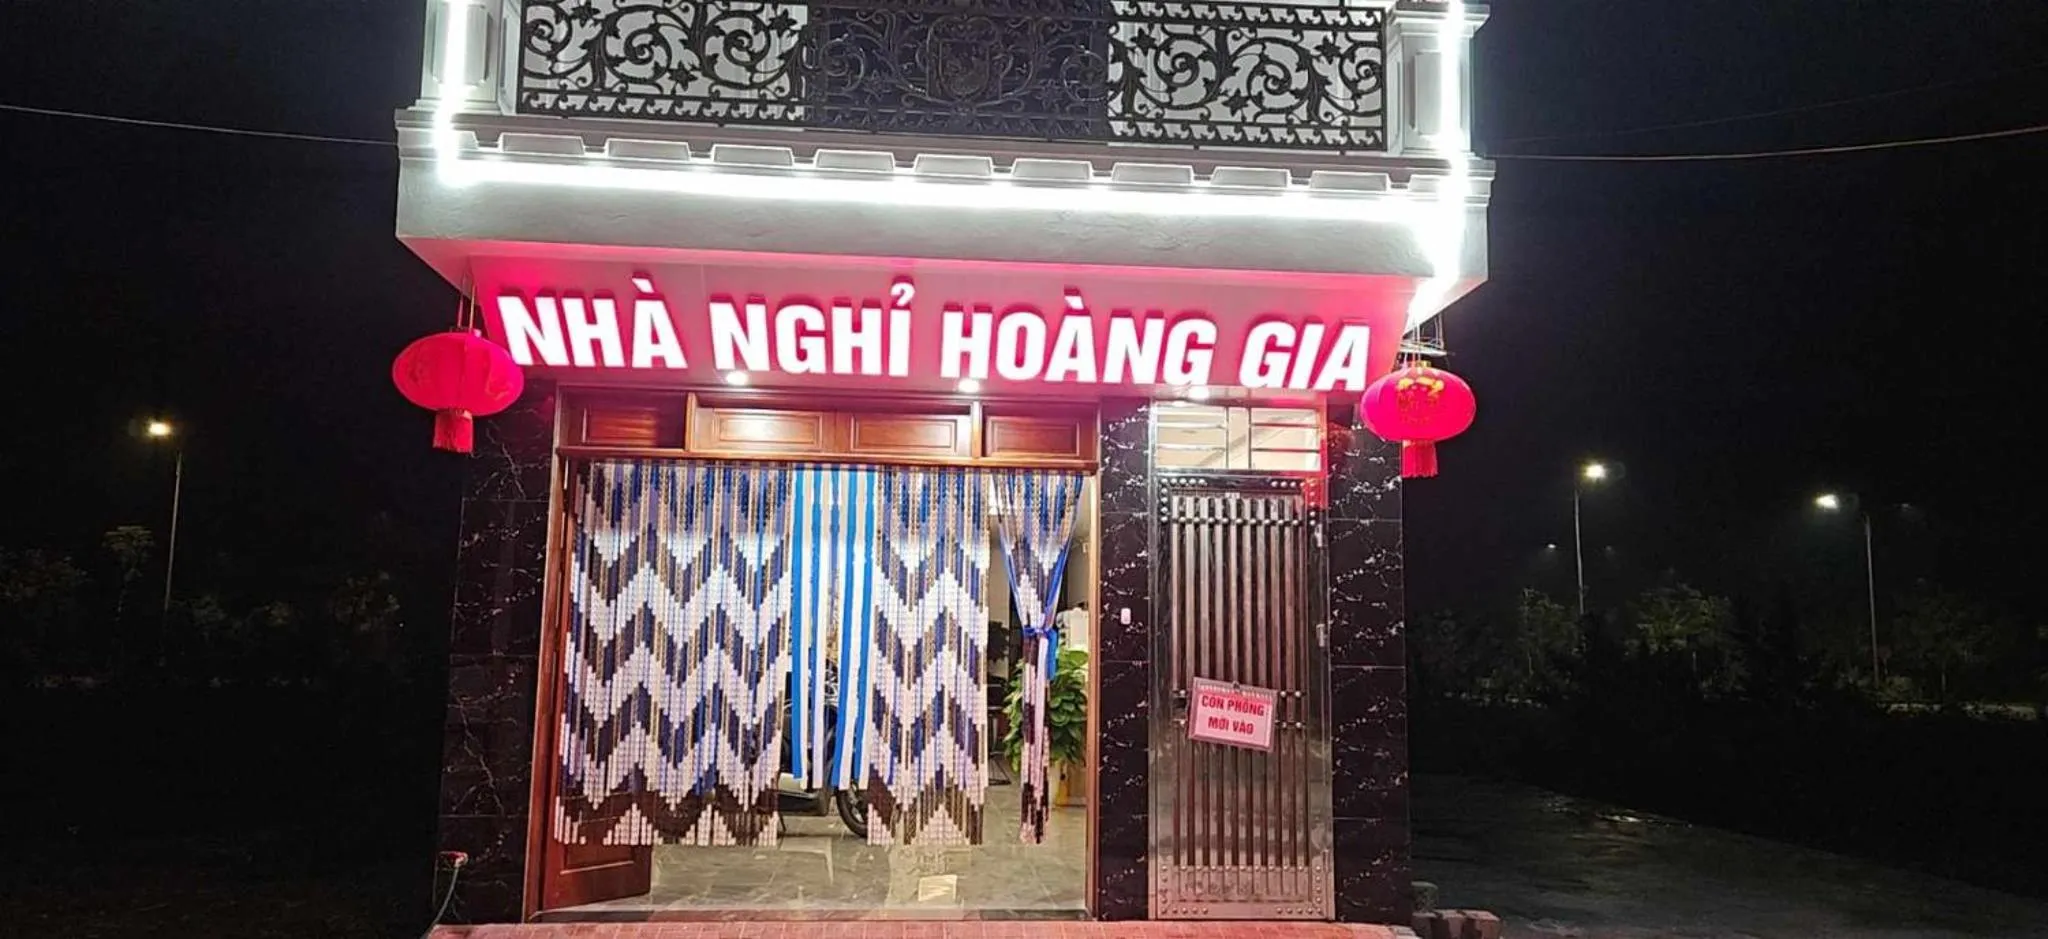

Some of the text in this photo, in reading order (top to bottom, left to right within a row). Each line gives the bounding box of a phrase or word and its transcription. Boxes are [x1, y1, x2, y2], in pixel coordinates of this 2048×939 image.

[497, 276, 1371, 391] NHÀ NGHỈ HOÀNG GIA
